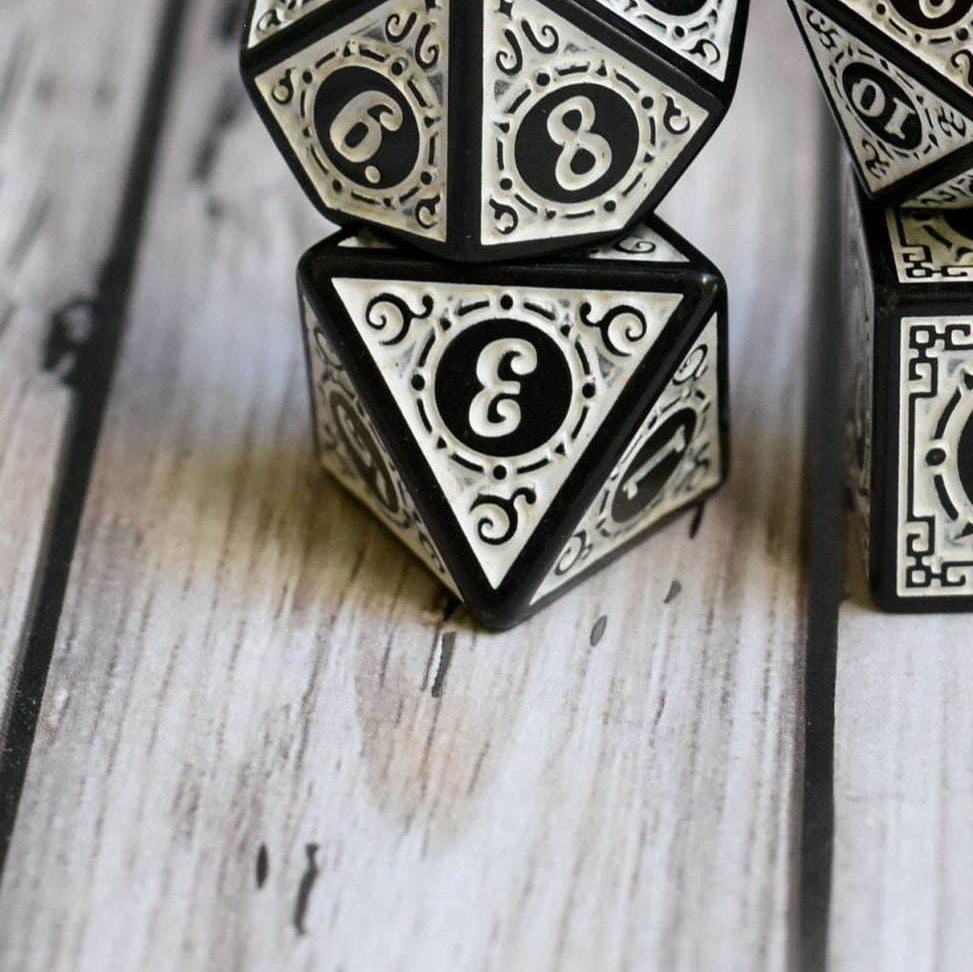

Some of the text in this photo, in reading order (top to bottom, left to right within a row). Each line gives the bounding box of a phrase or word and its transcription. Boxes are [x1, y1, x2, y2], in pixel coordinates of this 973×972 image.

[546, 94, 613, 191] 8
[850, 80, 917, 141] 10
[468, 337, 538, 438] 3
